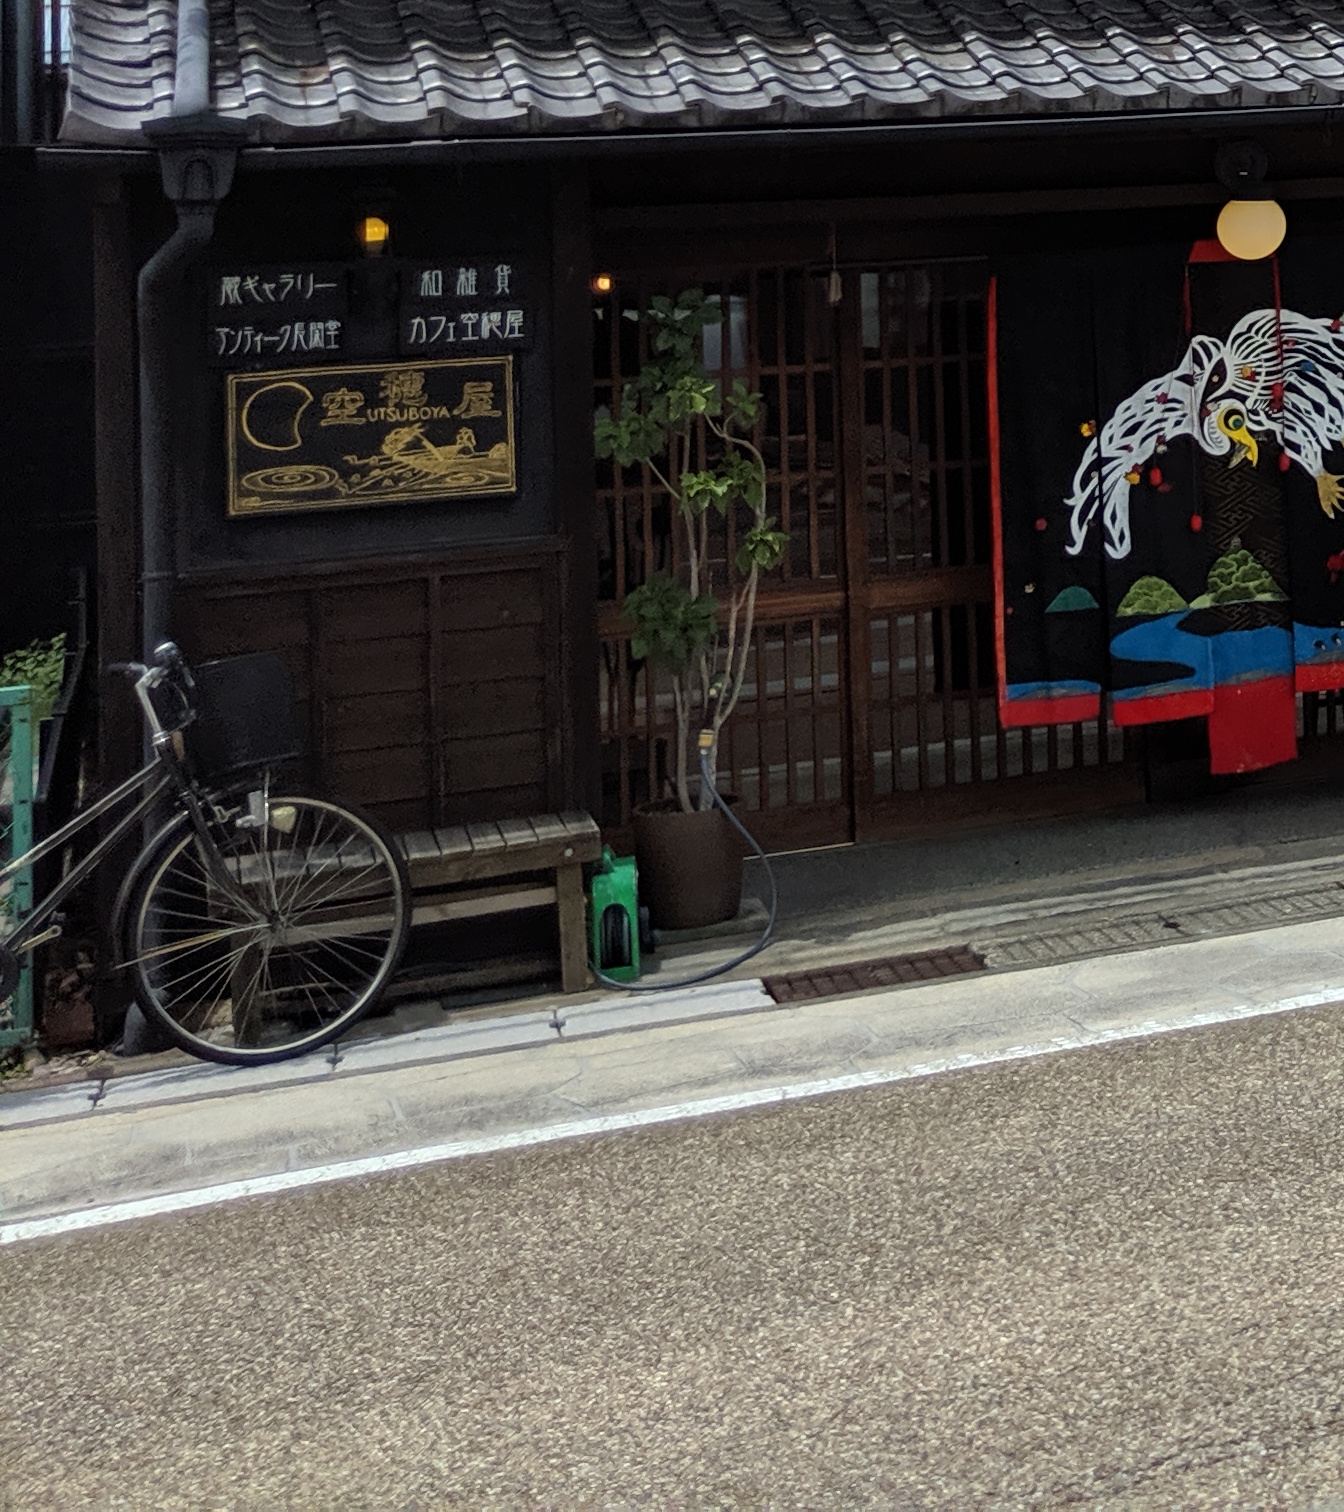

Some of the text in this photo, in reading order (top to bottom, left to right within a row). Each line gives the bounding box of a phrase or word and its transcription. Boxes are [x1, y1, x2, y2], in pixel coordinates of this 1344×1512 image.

[420, 264, 512, 296] 和雑貨
[367, 405, 451, 423] UTSUBOYA
